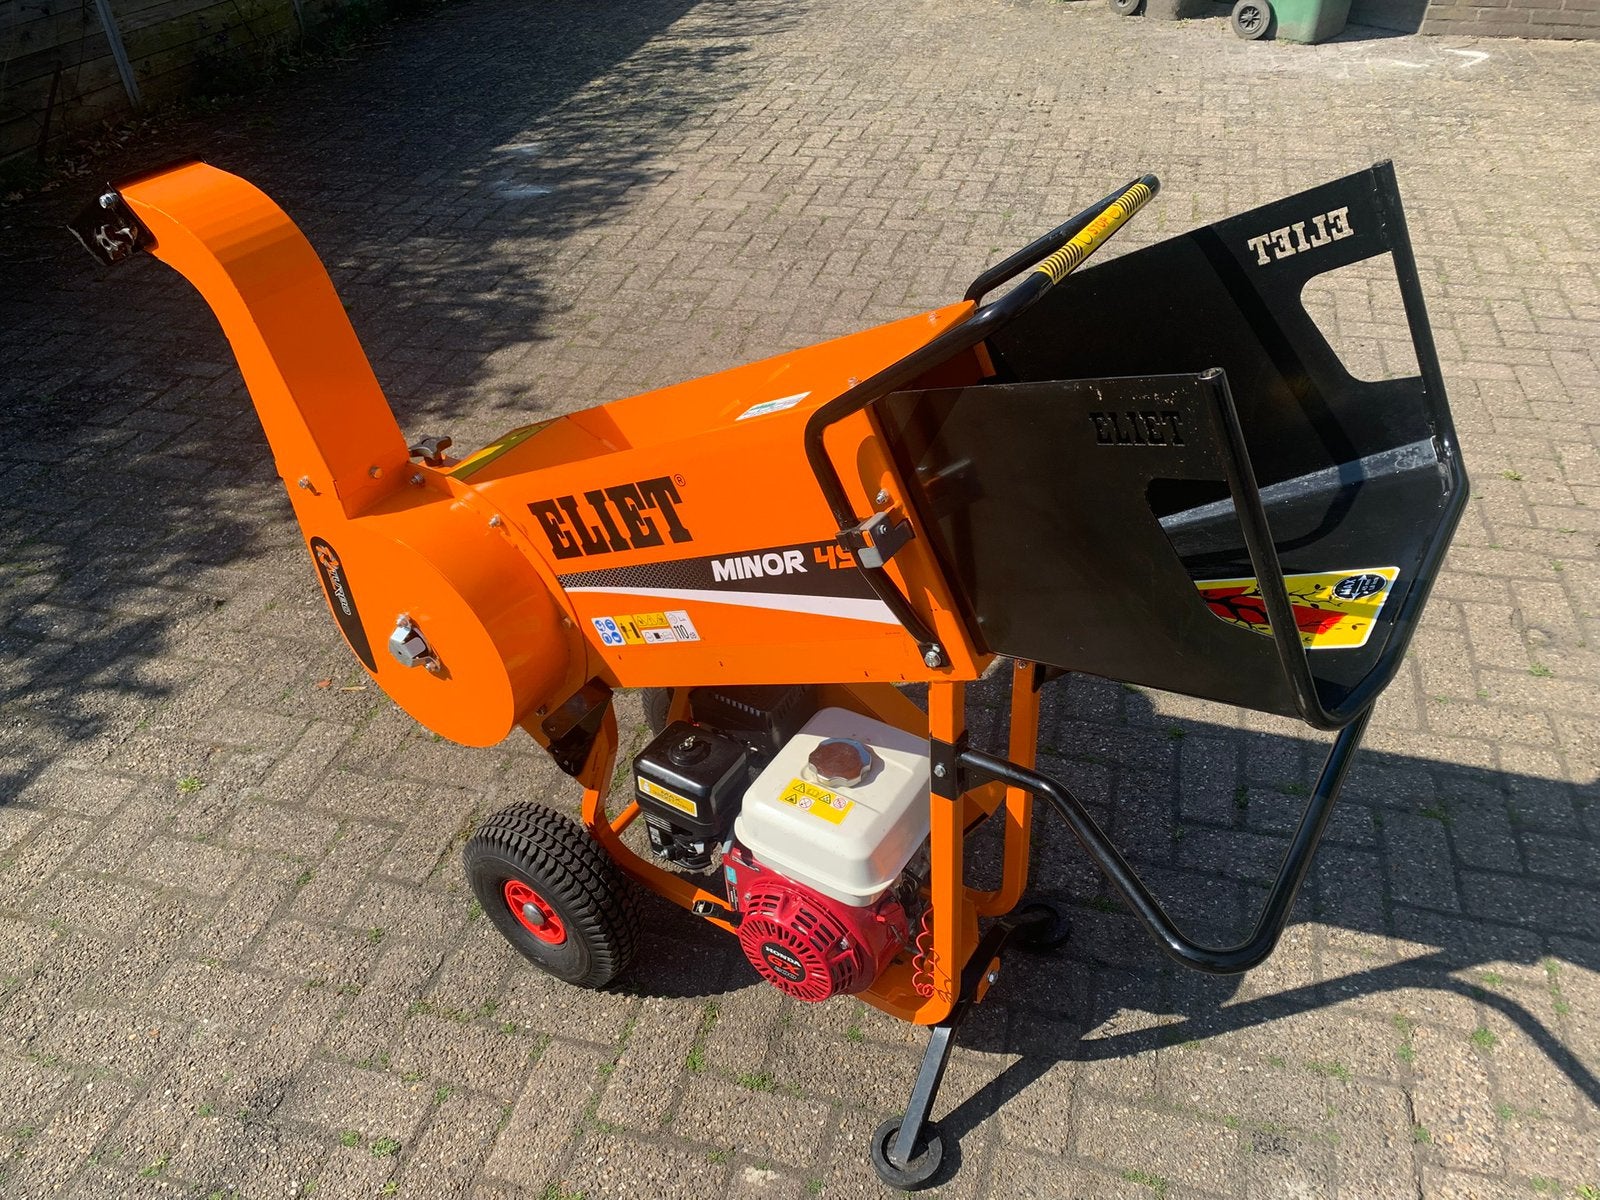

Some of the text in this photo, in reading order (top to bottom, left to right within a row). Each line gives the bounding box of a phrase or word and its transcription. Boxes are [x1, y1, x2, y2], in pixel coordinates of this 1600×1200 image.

[1088, 411, 1185, 447] ELIET
[527, 476, 693, 560] ELIET
[711, 550, 808, 582] MINOR
[673, 624, 690, 640] 110
[765, 945, 802, 968] HONDA
